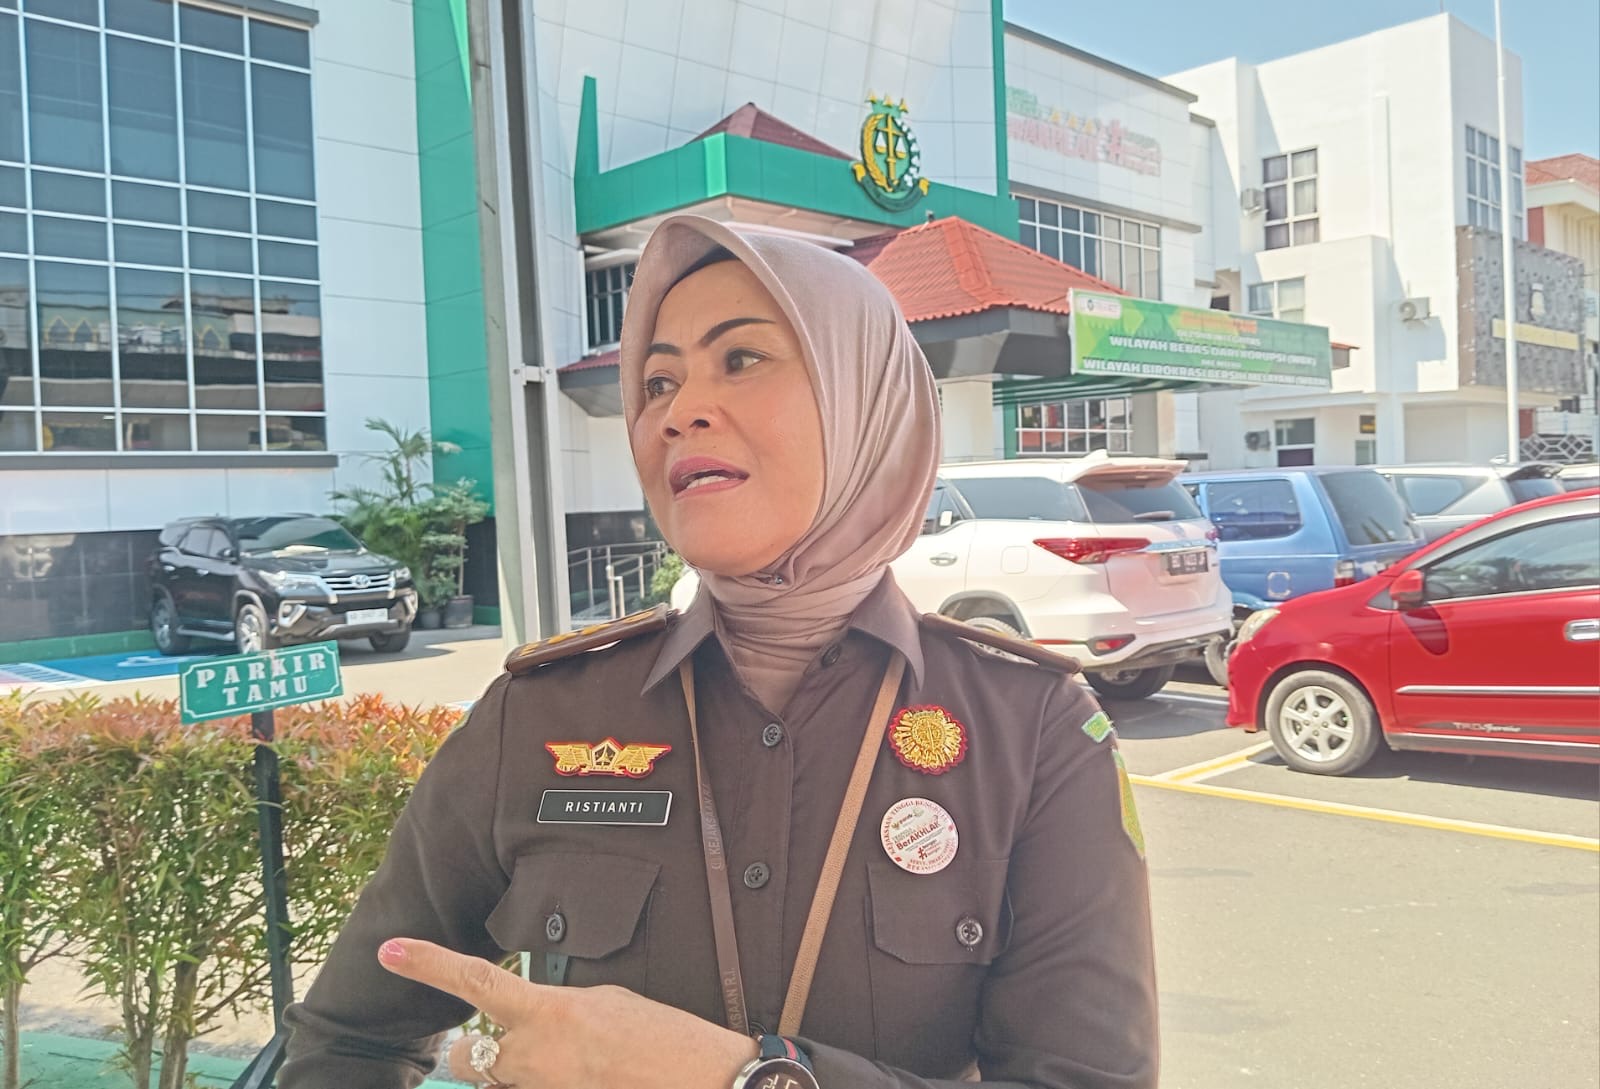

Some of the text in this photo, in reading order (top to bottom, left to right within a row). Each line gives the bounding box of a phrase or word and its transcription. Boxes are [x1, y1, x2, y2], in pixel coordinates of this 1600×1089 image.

[1109, 335, 1168, 351] WILAYAH
[1169, 342, 1210, 354] BEBAS
[1082, 357, 1140, 372] WILAYAH
[1142, 363, 1206, 377] BIROKRASI
[196, 652, 326, 689] PARKIR
[222, 675, 308, 706] TAMU
[565, 801, 643, 813] RISTIANTI
[896, 821, 940, 850] BerAKHLAK
